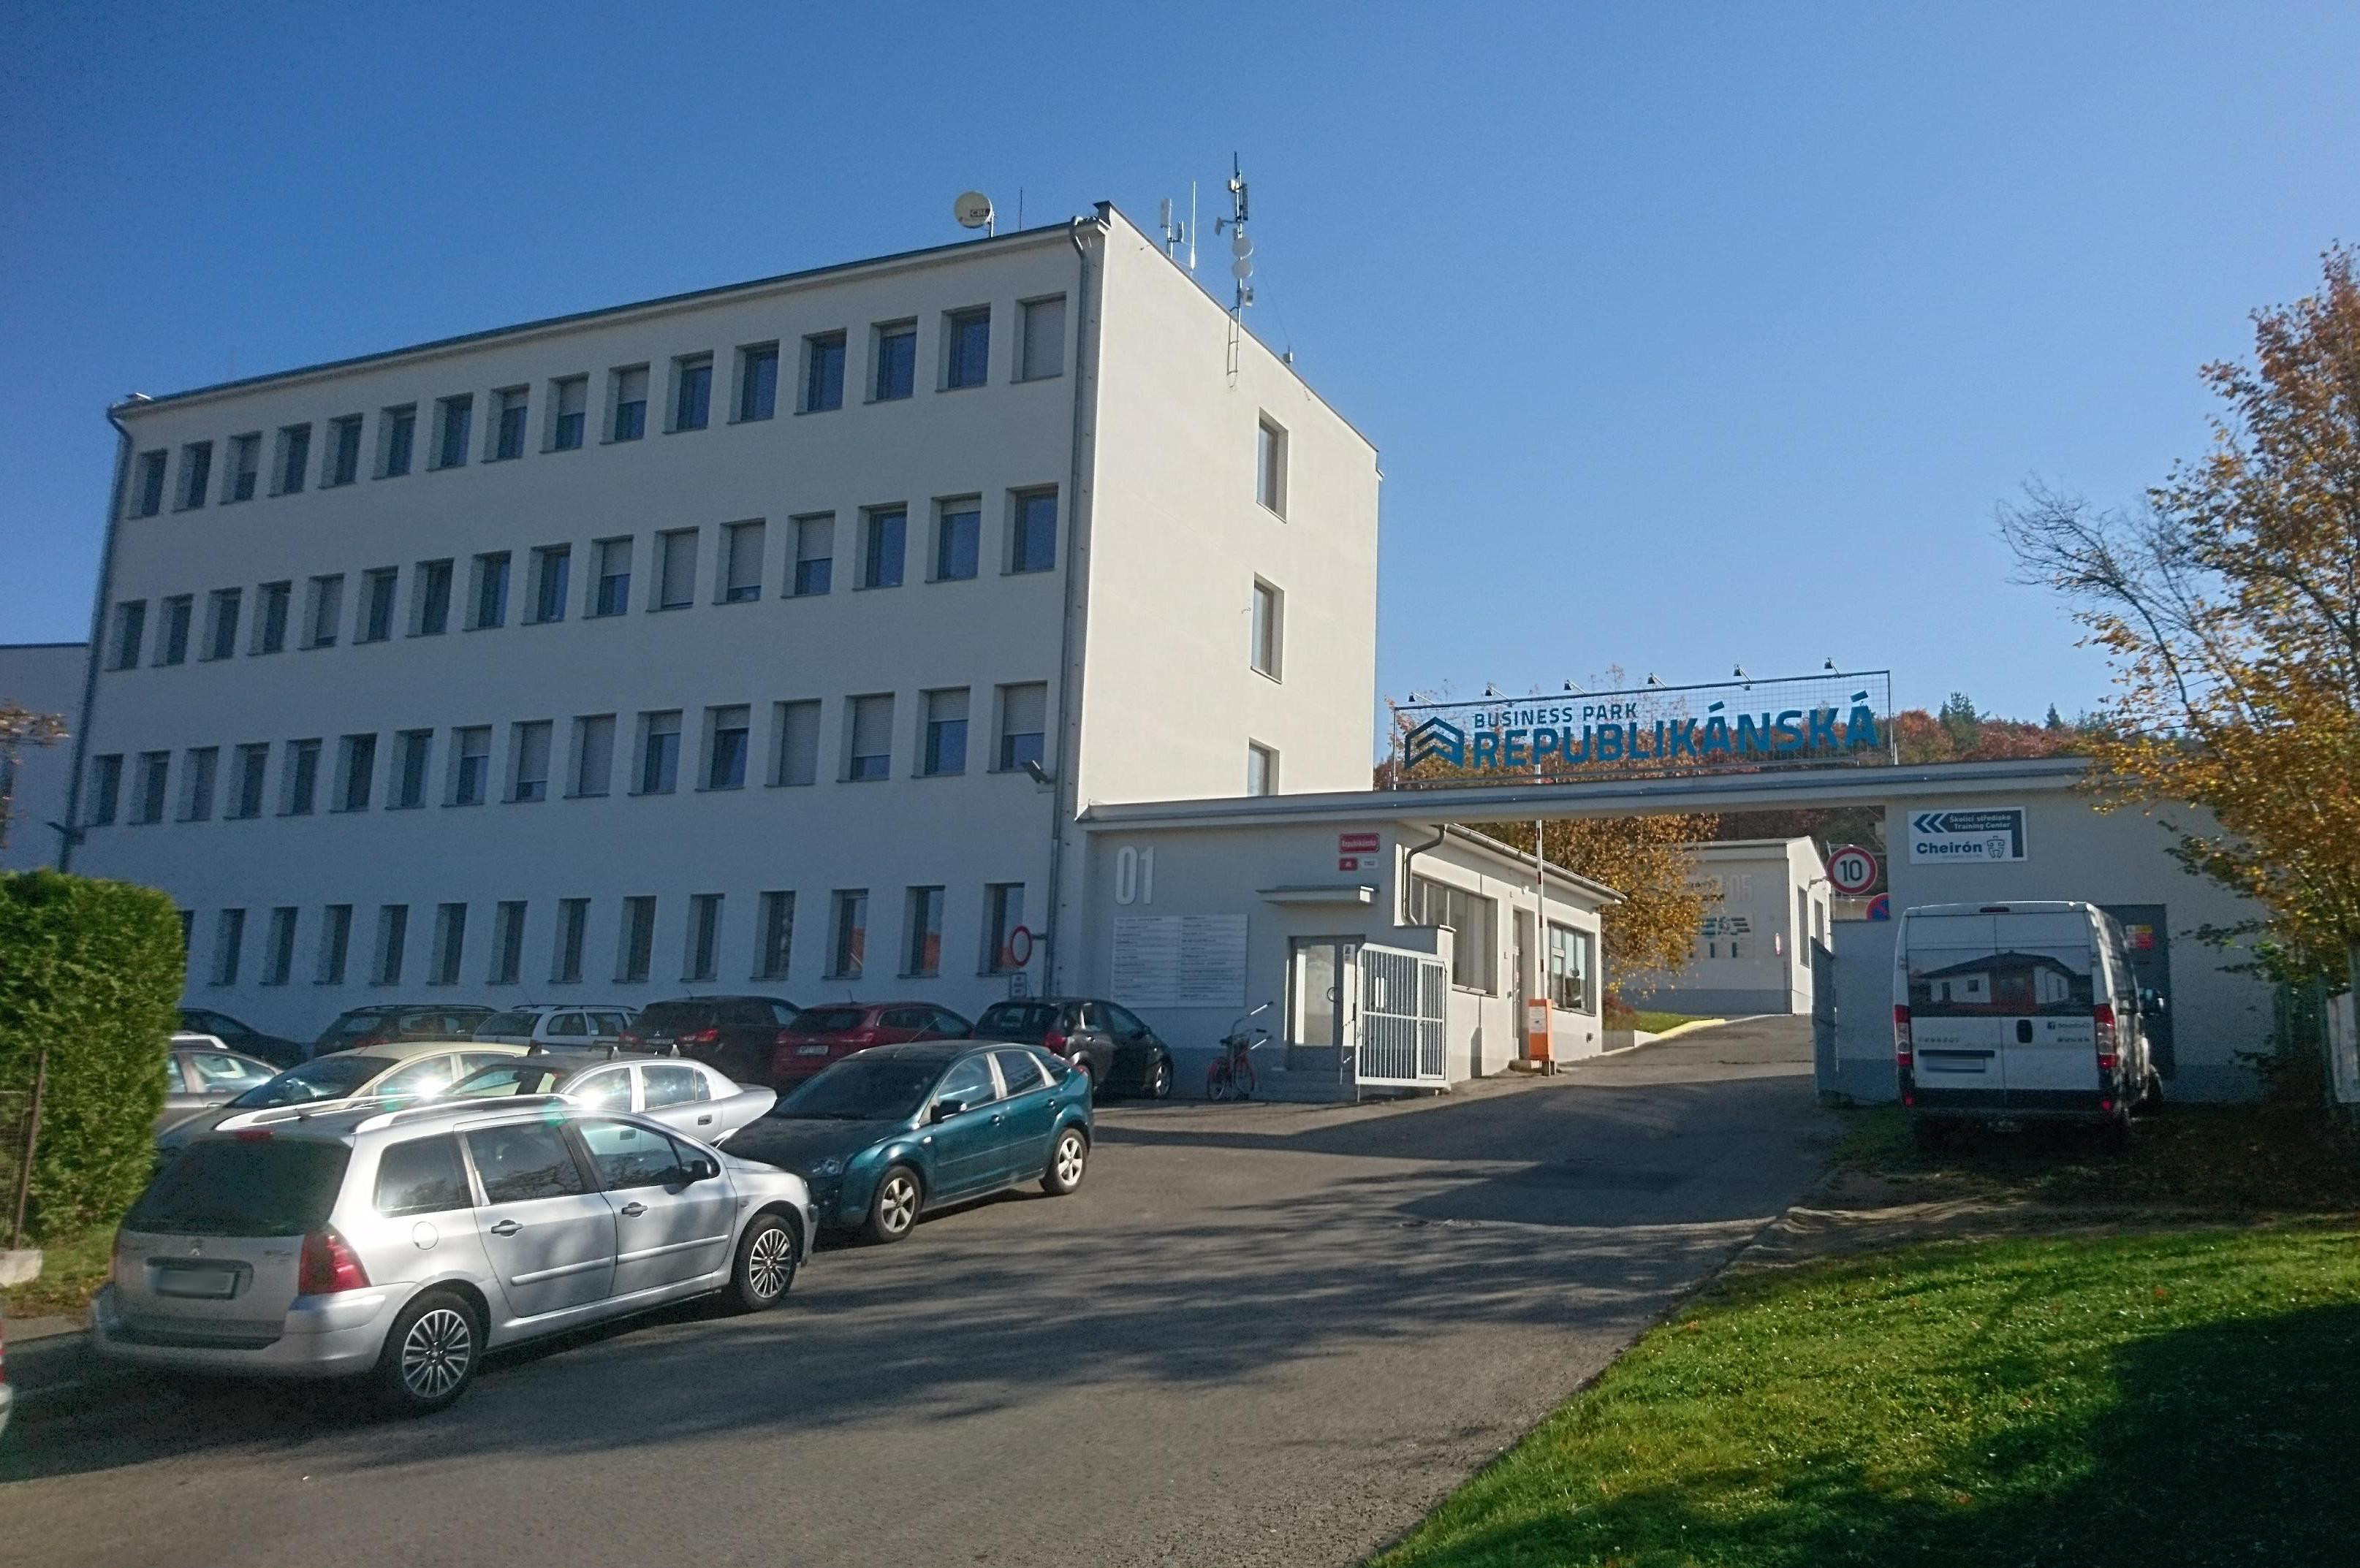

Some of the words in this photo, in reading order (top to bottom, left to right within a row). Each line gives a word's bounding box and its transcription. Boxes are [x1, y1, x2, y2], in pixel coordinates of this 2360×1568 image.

[1474, 707, 1573, 728] BUSINESS
[1582, 702, 1637, 721] PARK
[1473, 690, 1879, 768] REPUBLIKÁNSKÁ
[1954, 823, 1984, 831] Training
[1916, 841, 1983, 854] Cheirón
[1115, 845, 1155, 905] 01
[1840, 859, 1863, 881] 10
